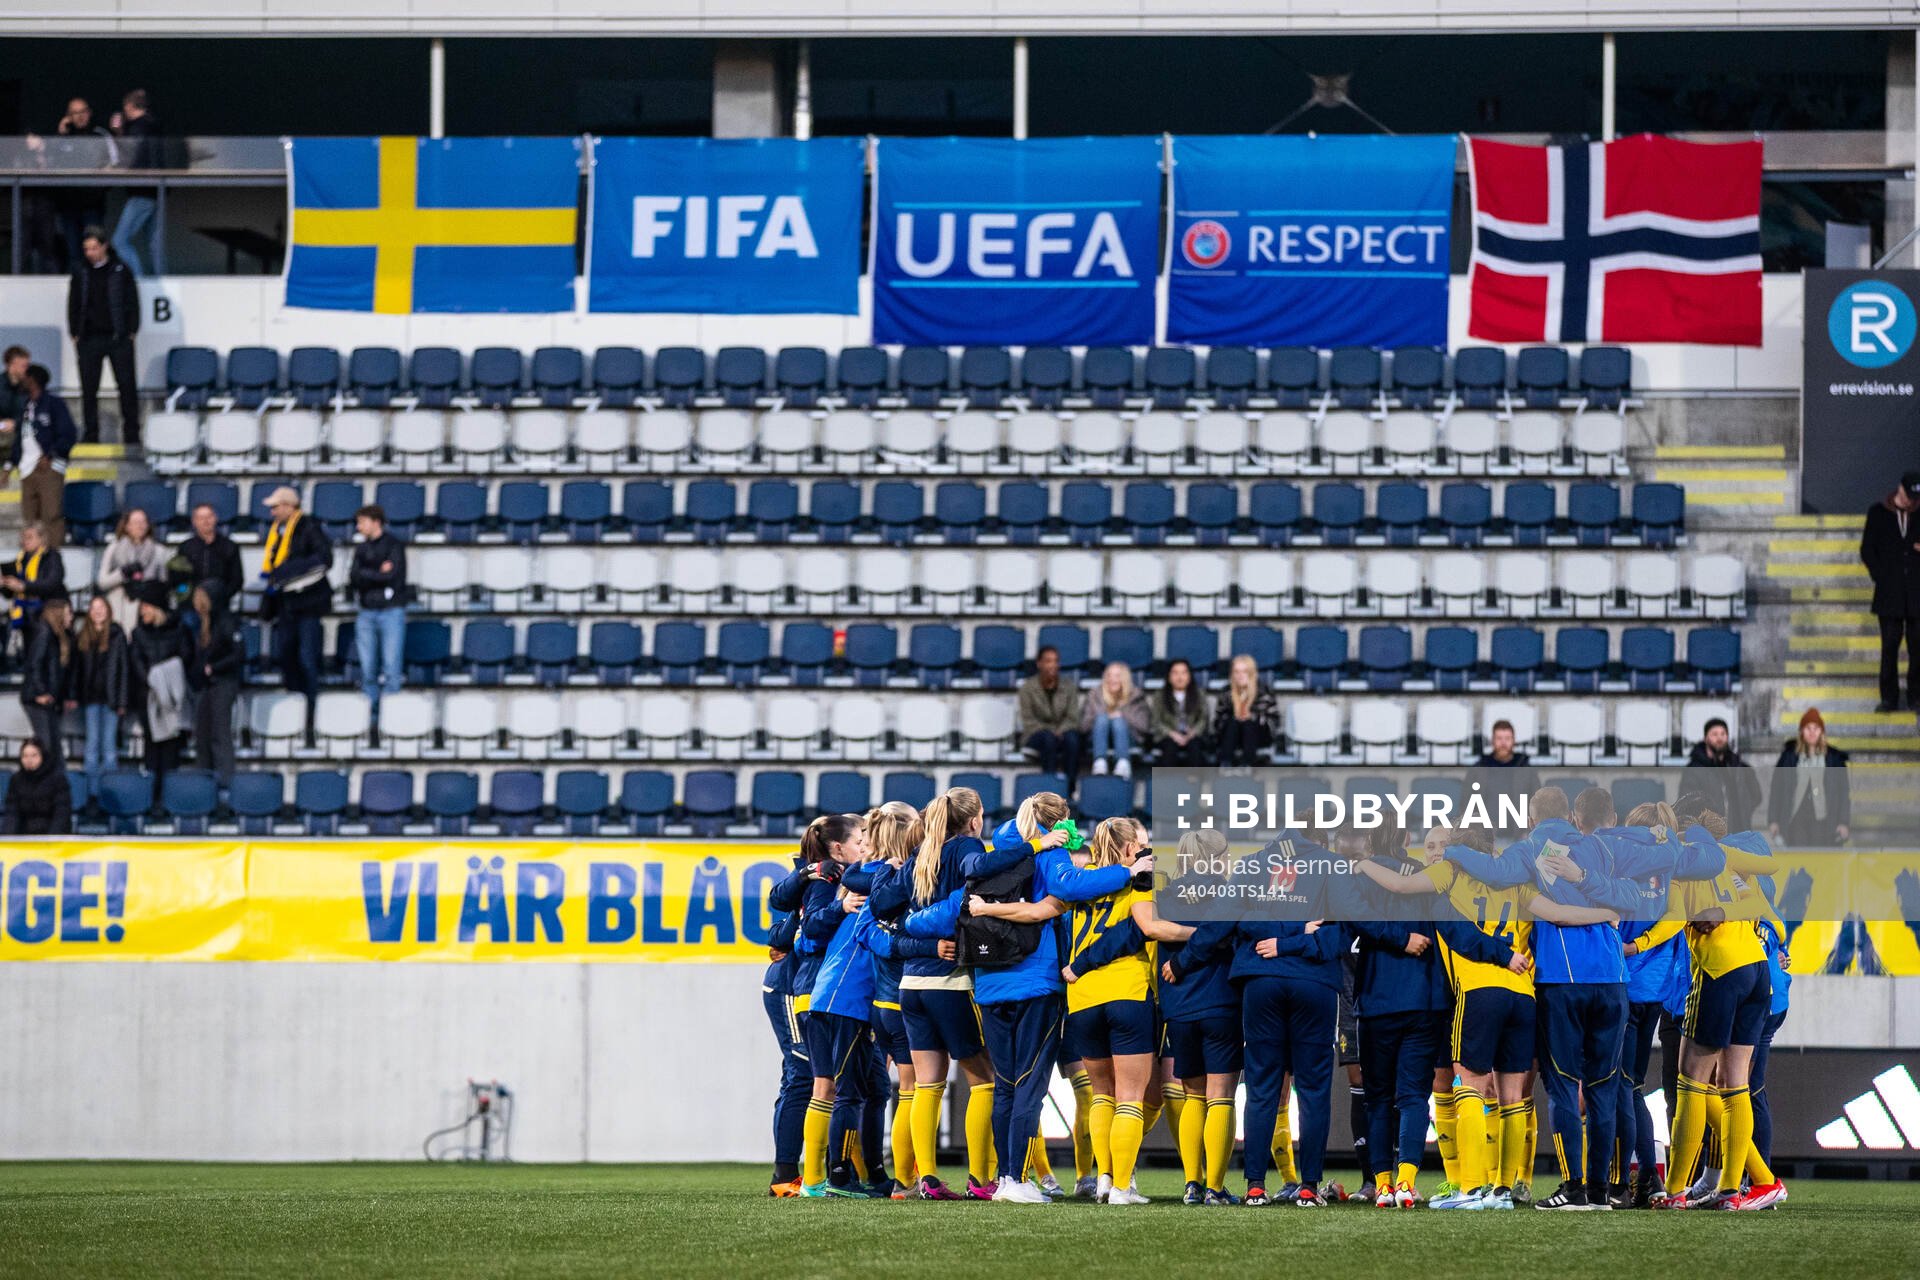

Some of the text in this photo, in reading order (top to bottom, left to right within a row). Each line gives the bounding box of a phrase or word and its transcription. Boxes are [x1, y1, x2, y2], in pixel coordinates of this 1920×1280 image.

[631, 196, 819, 258] FIFA
[896, 212, 1134, 278] UEFA
[1248, 224, 1447, 264] RESPECT
[153, 297, 172, 322] B
[1828, 380, 1914, 396] errevision.se
[0, 860, 128, 943] GE!
[361, 862, 438, 942] VI
[458, 856, 566, 943] ÄR
